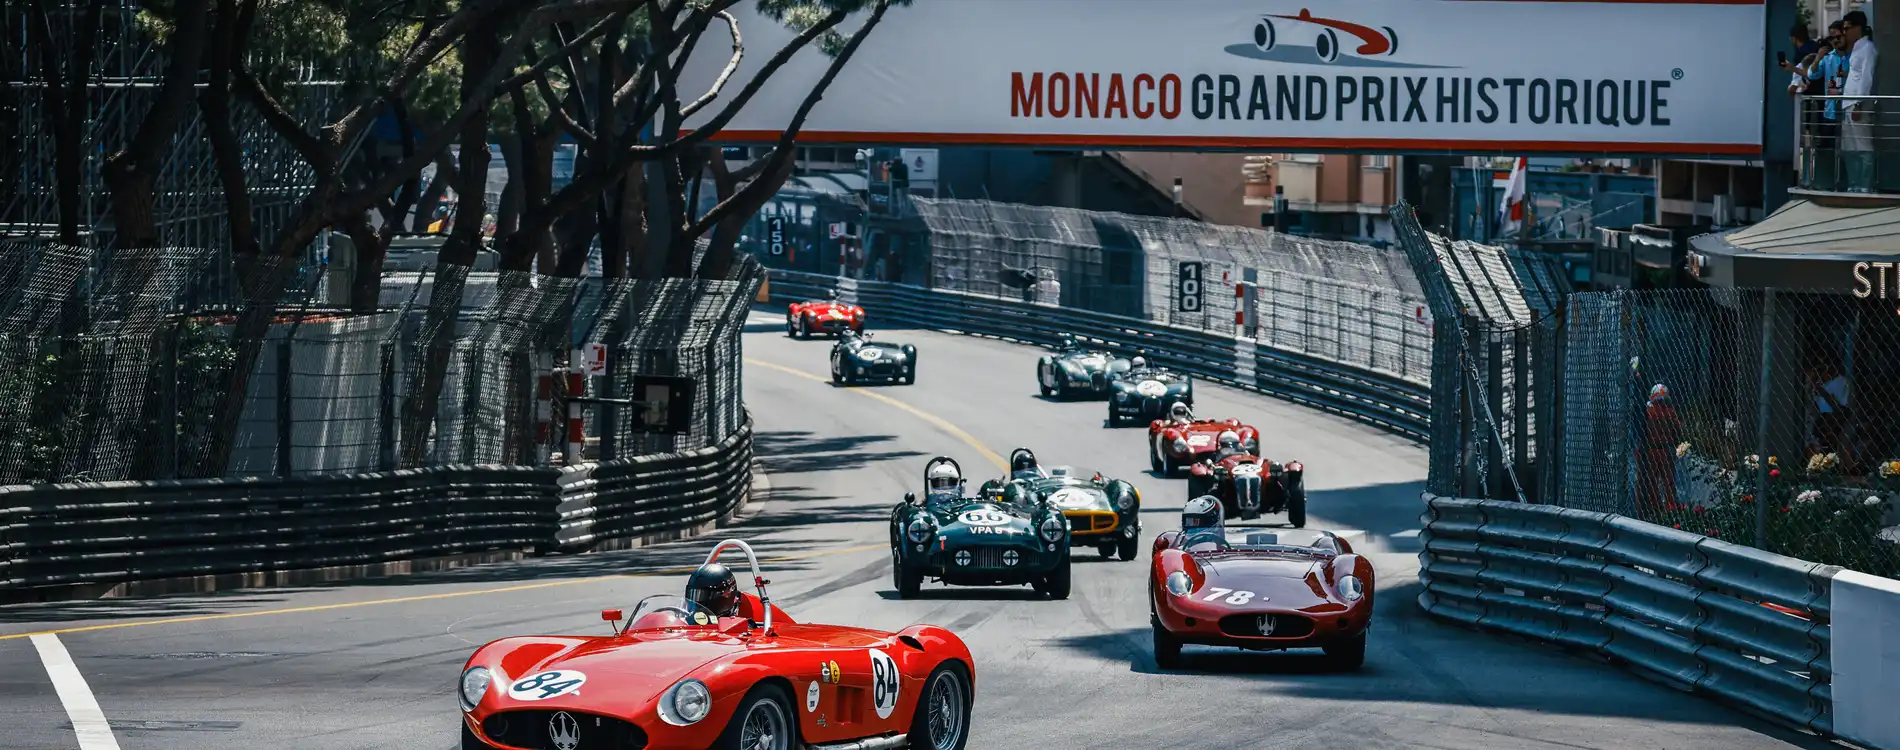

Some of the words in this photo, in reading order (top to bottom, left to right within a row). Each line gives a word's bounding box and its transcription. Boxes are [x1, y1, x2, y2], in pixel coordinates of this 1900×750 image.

[1010, 72, 1182, 120] MONACO
[1191, 74, 1328, 121] GRAND
[1335, 76, 1428, 122] PRIX
[1435, 77, 1672, 127] HISTORIQUE
[771, 219, 783, 255] 150
[1183, 264, 1198, 311] 100
[966, 513, 1002, 523] 66
[969, 526, 993, 535] VPA
[1203, 587, 1256, 605] 78
[513, 671, 583, 699] 84
[873, 657, 898, 709] 84
